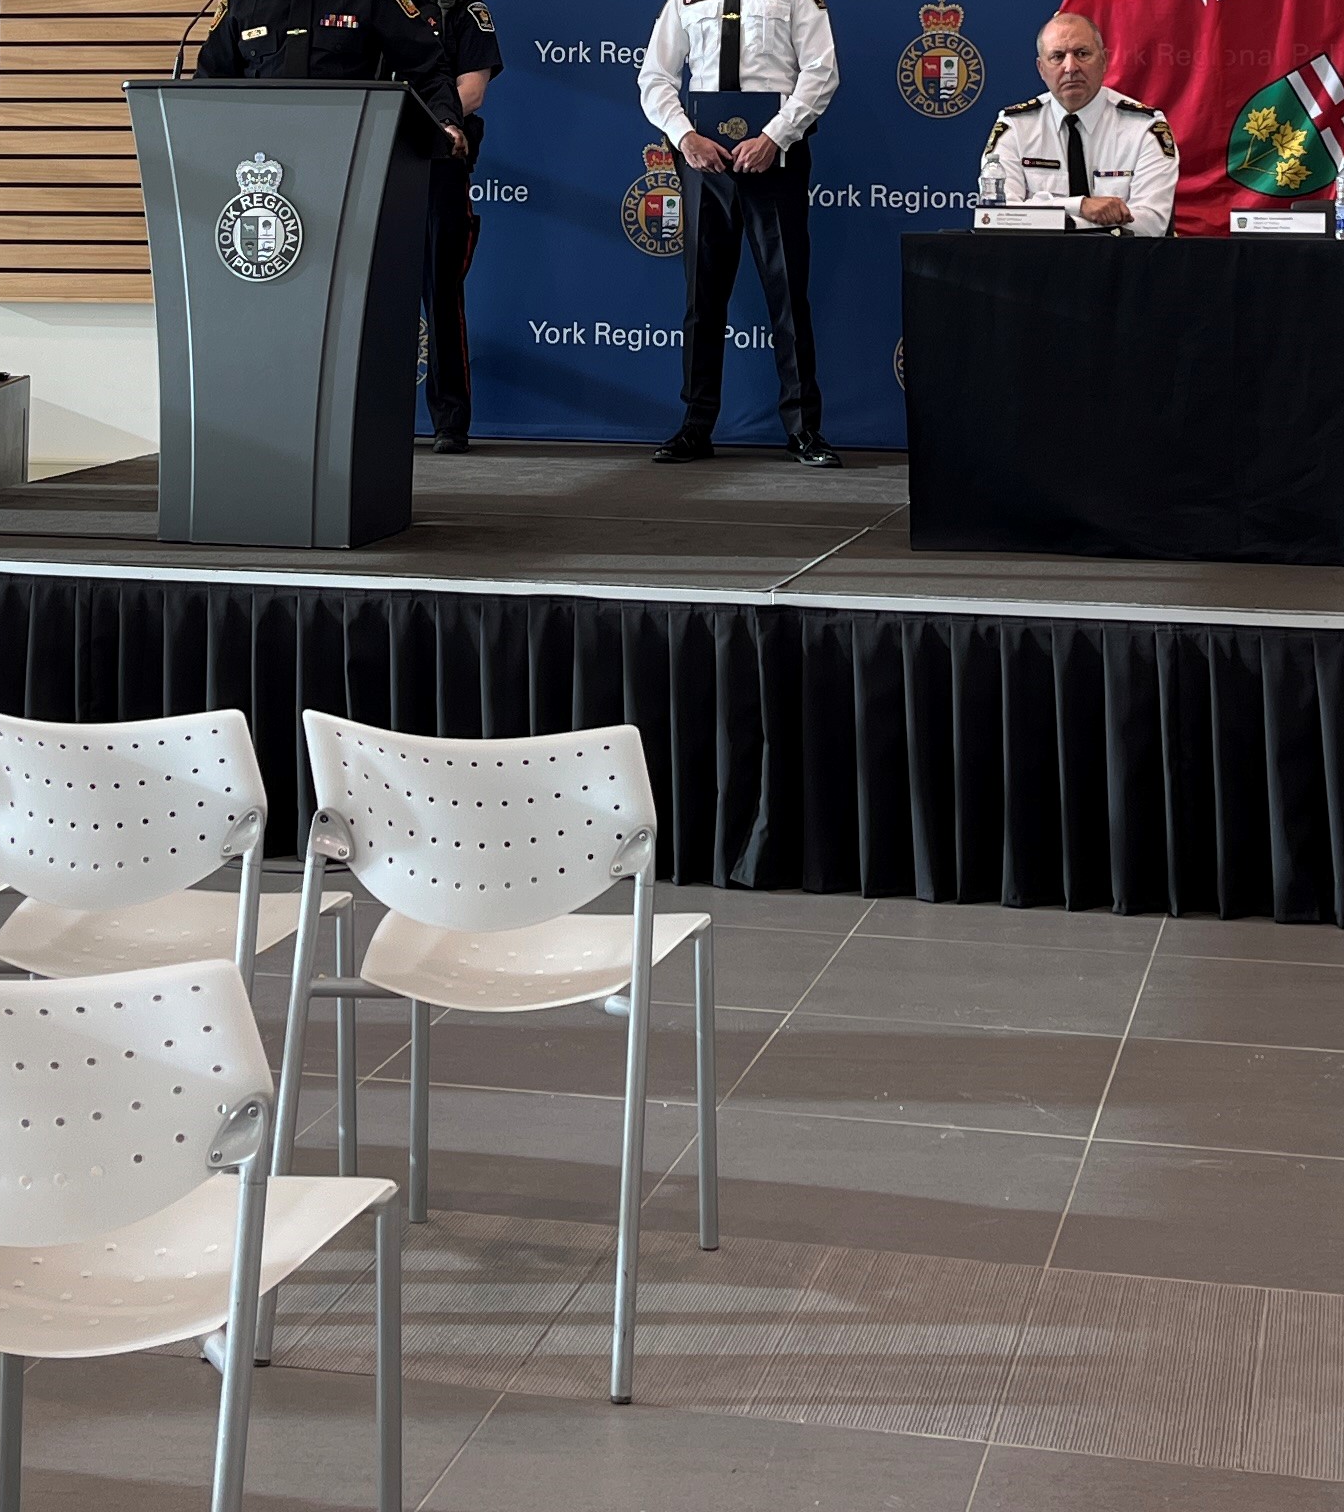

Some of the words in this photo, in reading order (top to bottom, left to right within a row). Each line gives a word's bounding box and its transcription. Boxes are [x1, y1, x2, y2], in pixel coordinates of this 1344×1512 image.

[535, 41, 591, 63] York
[922, 34, 980, 89] REGIONAL
[901, 49, 922, 95] YORK
[914, 92, 967, 114] POLICE
[469, 179, 528, 202] olice
[807, 184, 861, 207] York
[871, 184, 980, 214] Regiona
[241, 193, 299, 251] REGIONAL
[625, 188, 647, 234] YORK
[219, 209, 241, 258] YORK
[233, 255, 286, 278] POLICE
[529, 321, 586, 345] York
[595, 323, 684, 352] Region
